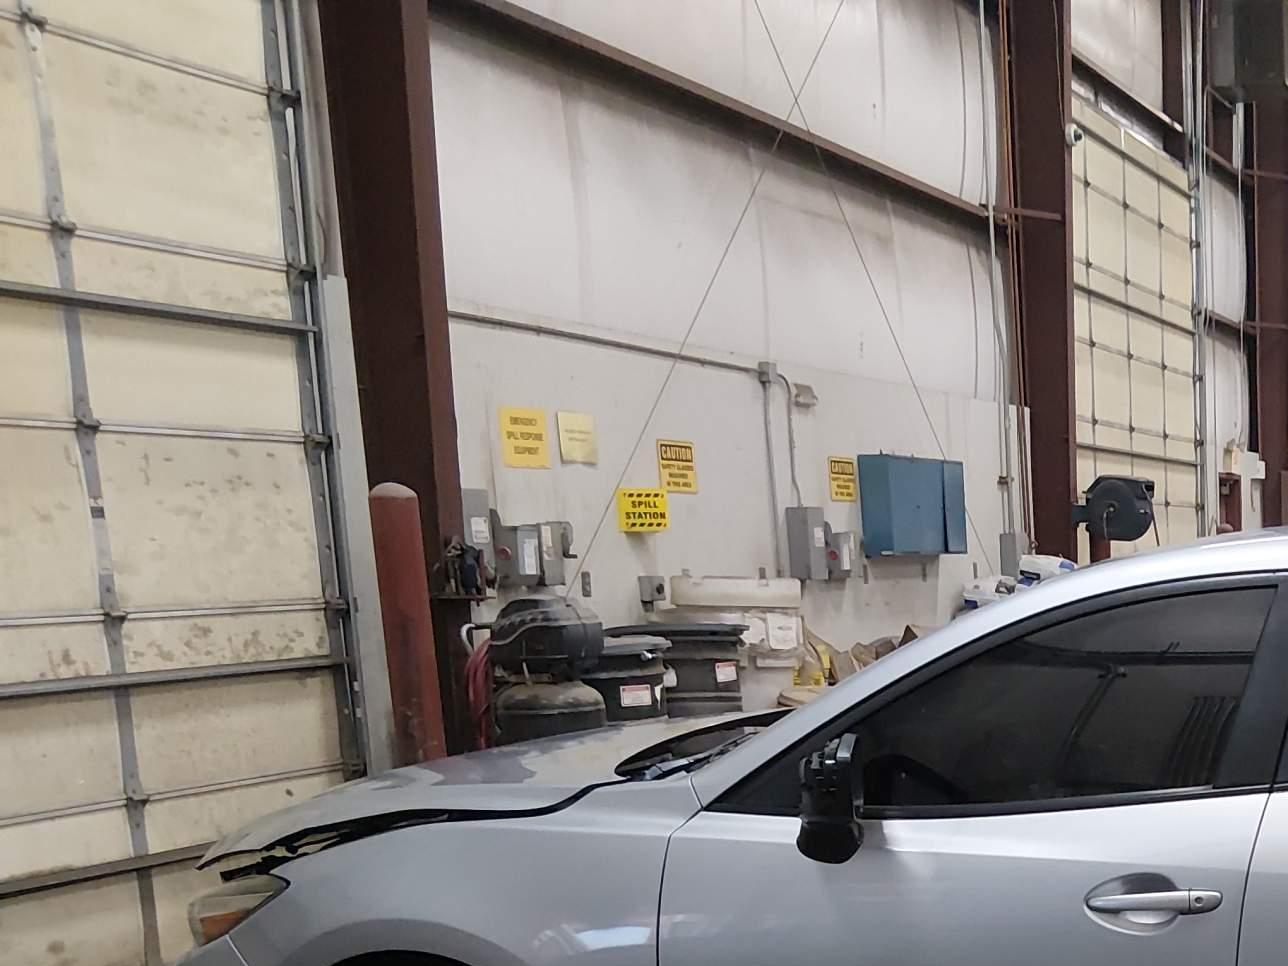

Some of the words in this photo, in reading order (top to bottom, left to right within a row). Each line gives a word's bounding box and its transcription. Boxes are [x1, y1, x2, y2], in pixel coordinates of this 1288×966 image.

[661, 446, 692, 461] CAUTION
[631, 500, 659, 509] SPILL
[625, 511, 666, 520] STATION
